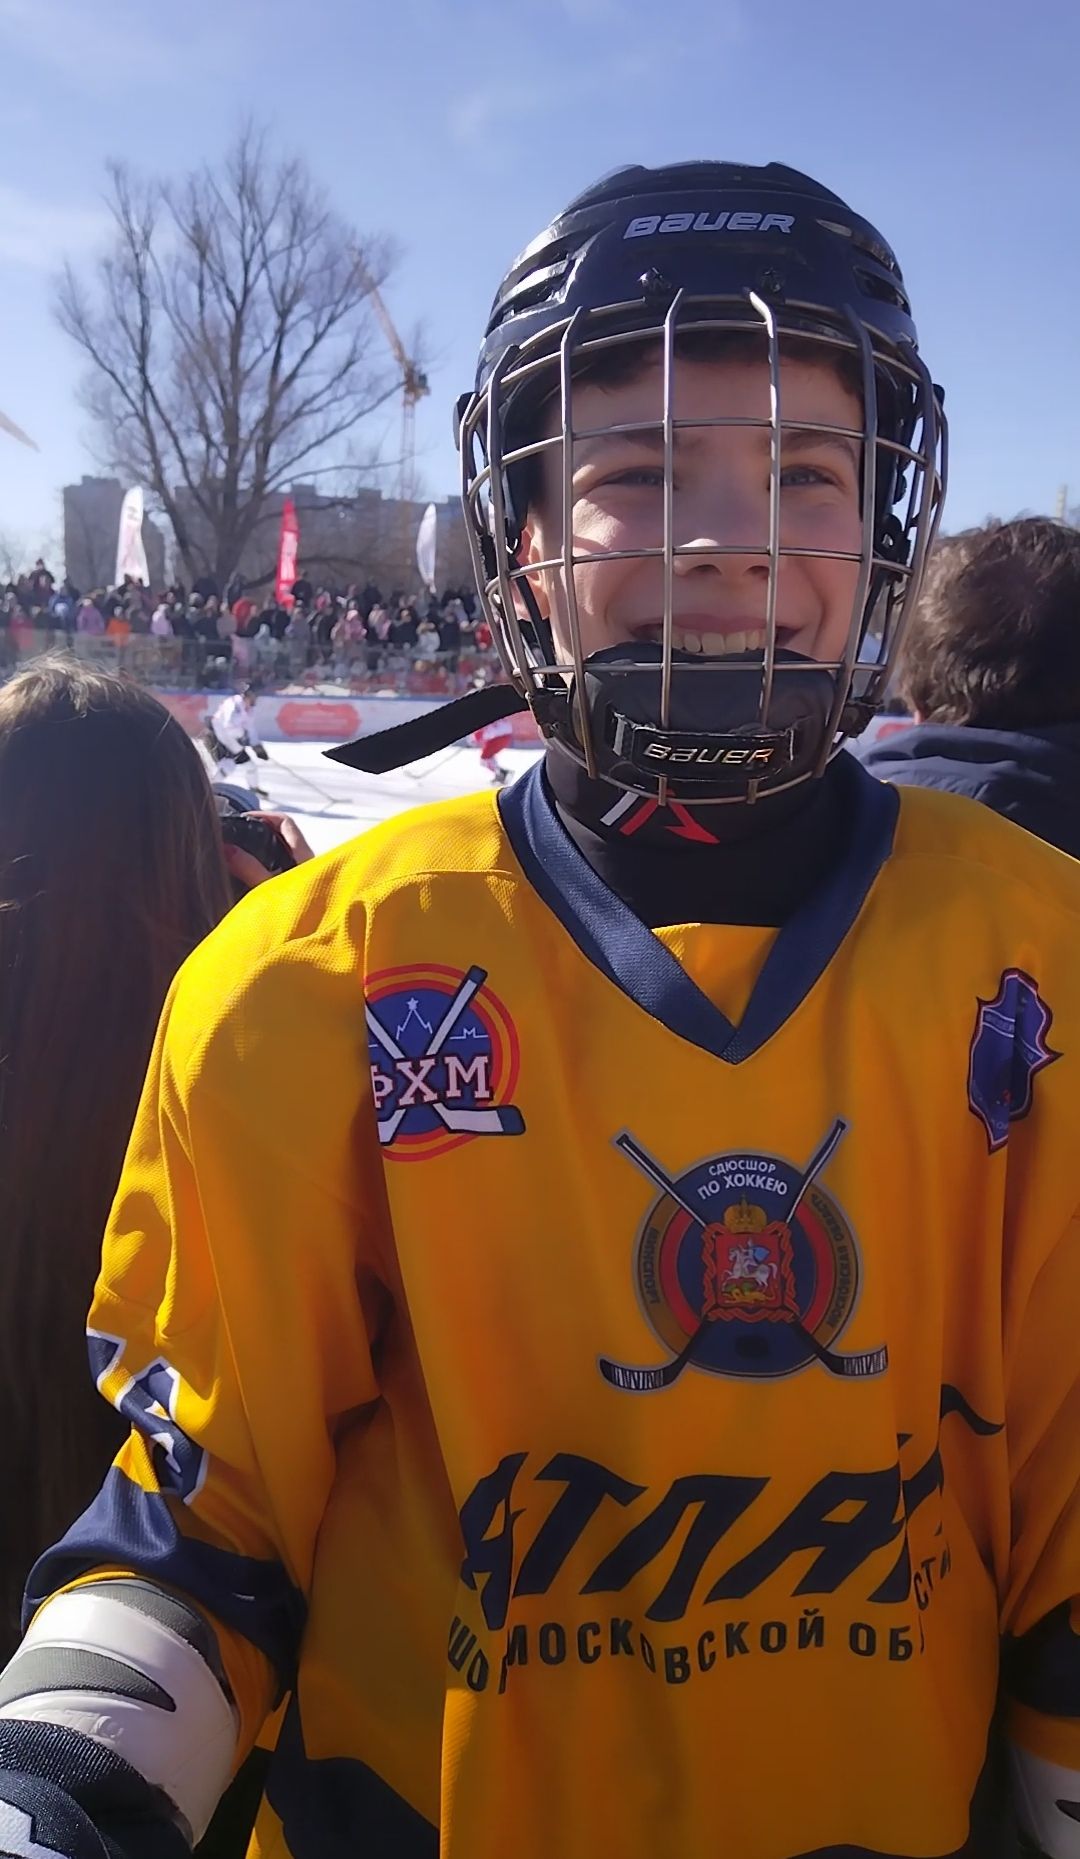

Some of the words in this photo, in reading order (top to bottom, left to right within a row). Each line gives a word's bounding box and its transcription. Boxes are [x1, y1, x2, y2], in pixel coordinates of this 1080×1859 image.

[708, 1159, 776, 1176] СДЮСШОР
[696, 1180, 720, 1200] ПО
[723, 1173, 788, 1196] ХОККЕЮ
